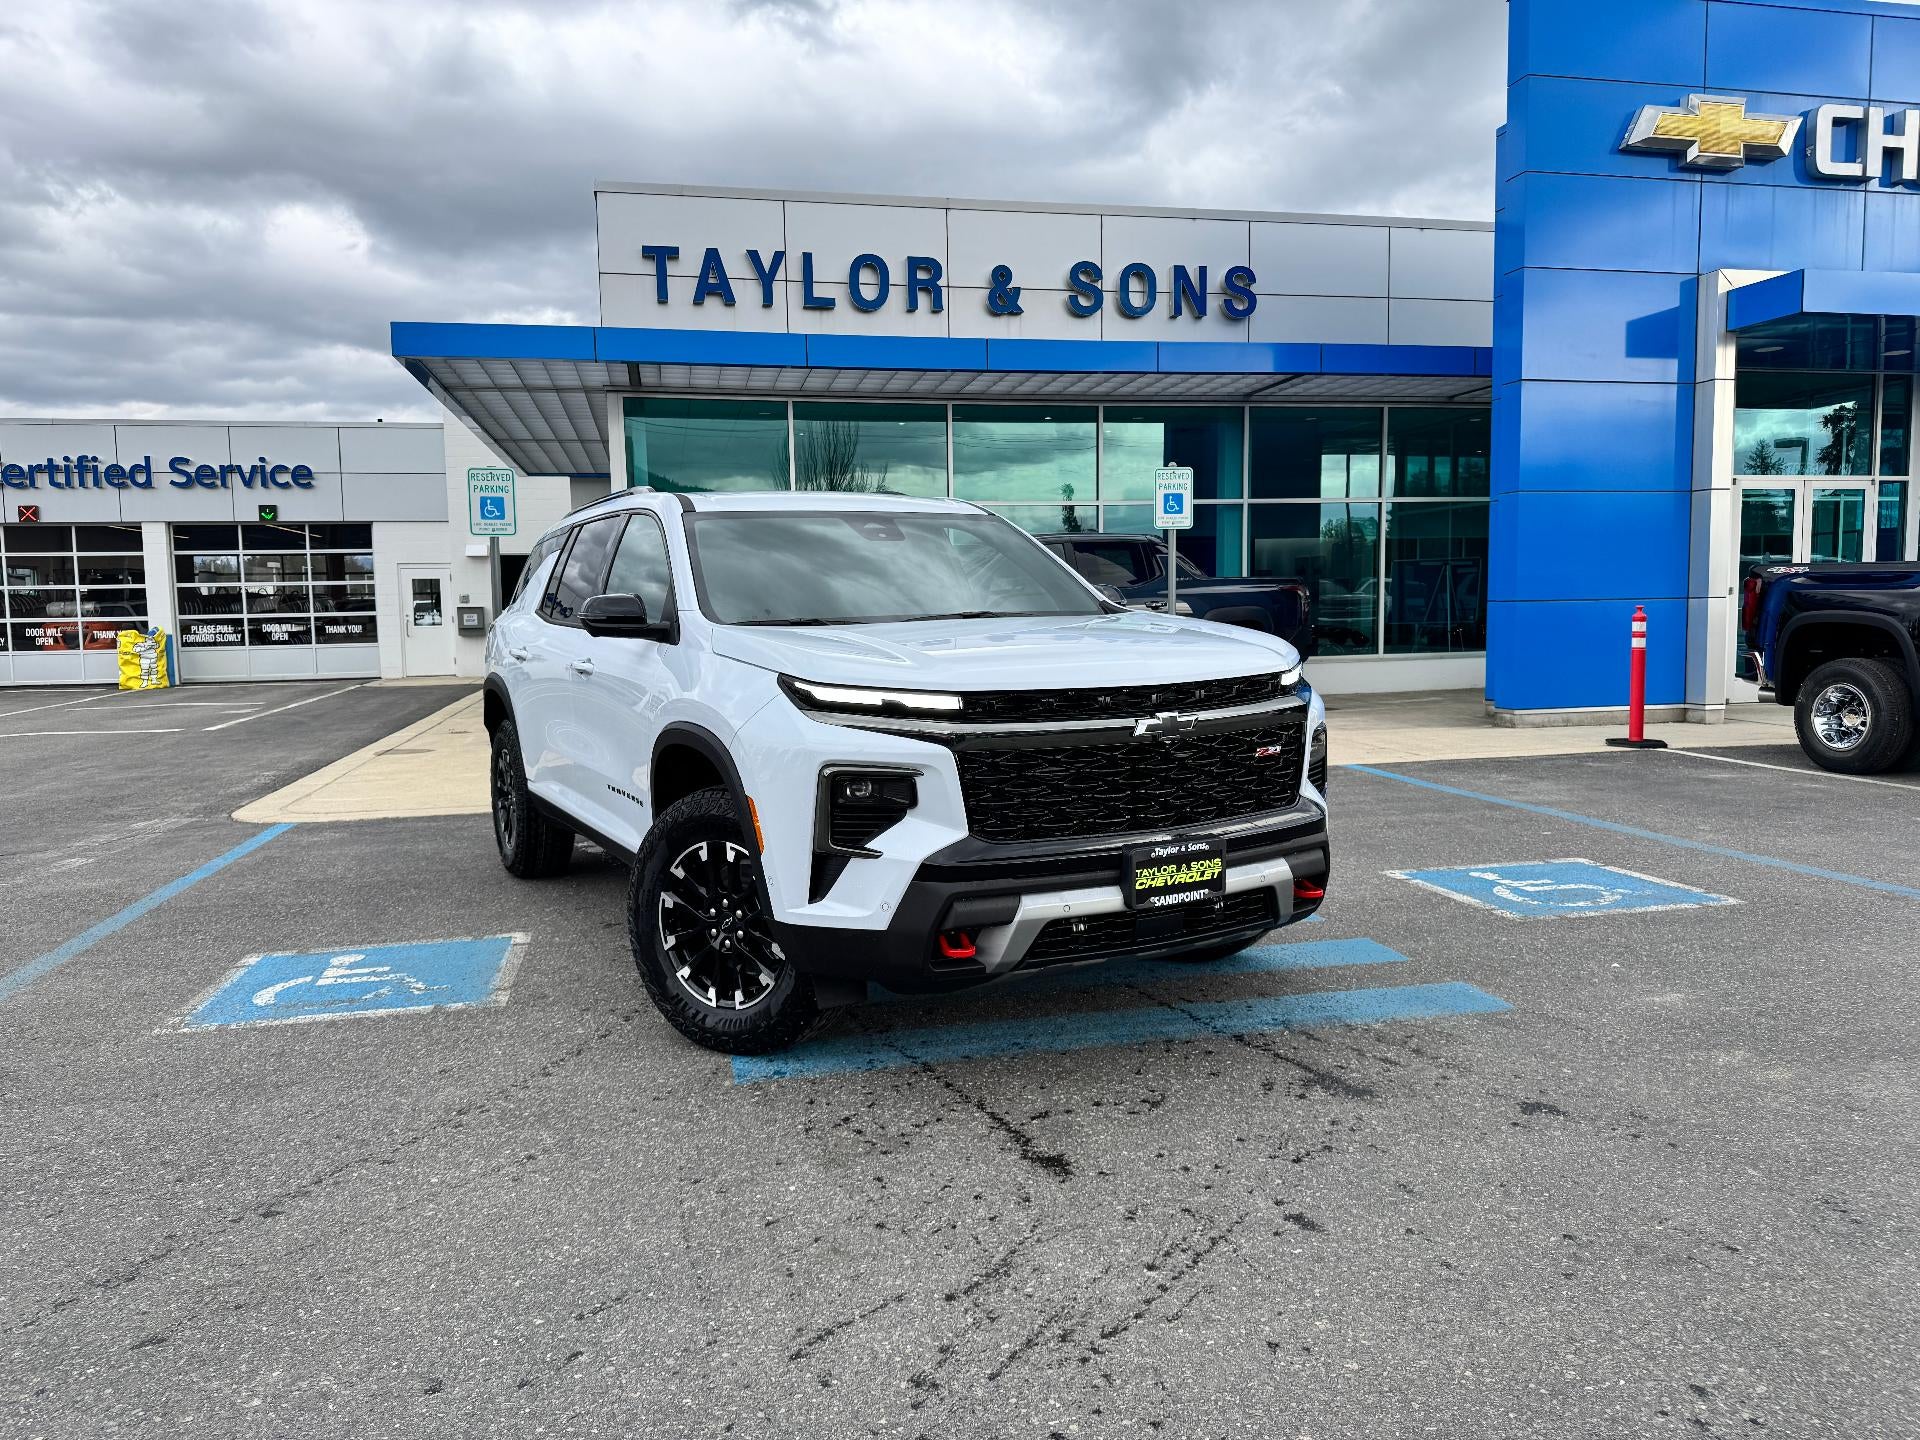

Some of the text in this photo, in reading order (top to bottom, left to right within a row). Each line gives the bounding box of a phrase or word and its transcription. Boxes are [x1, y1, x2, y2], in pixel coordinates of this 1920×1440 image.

[641, 245, 1258, 320] TAYLOR & SONS
[168, 456, 315, 489] Service
[1157, 472, 1190, 480] RESERVED
[470, 473, 511, 482] RESERVED
[473, 485, 509, 493] PARKING
[1158, 483, 1188, 491] PARKING
[25, 628, 45, 637] DOOR
[45, 628, 63, 637] WILL
[191, 625, 233, 634] PLEASE PULL
[262, 624, 281, 633] DOOR
[325, 625, 362, 634] THANK YOU!
[93, 630, 116, 639] THANK
[182, 633, 242, 643] FORWARD SLOWLY
[271, 632, 289, 641] OPEN
[35, 636, 54, 646] OPEN
[1154, 845, 1180, 858] Taylor
[1187, 842, 1207, 852] Sons
[1135, 857, 1222, 878] TAYLOR & SONS
[1135, 869, 1222, 890] CHEVROLET
[1154, 889, 1205, 907] SANDPOINT
